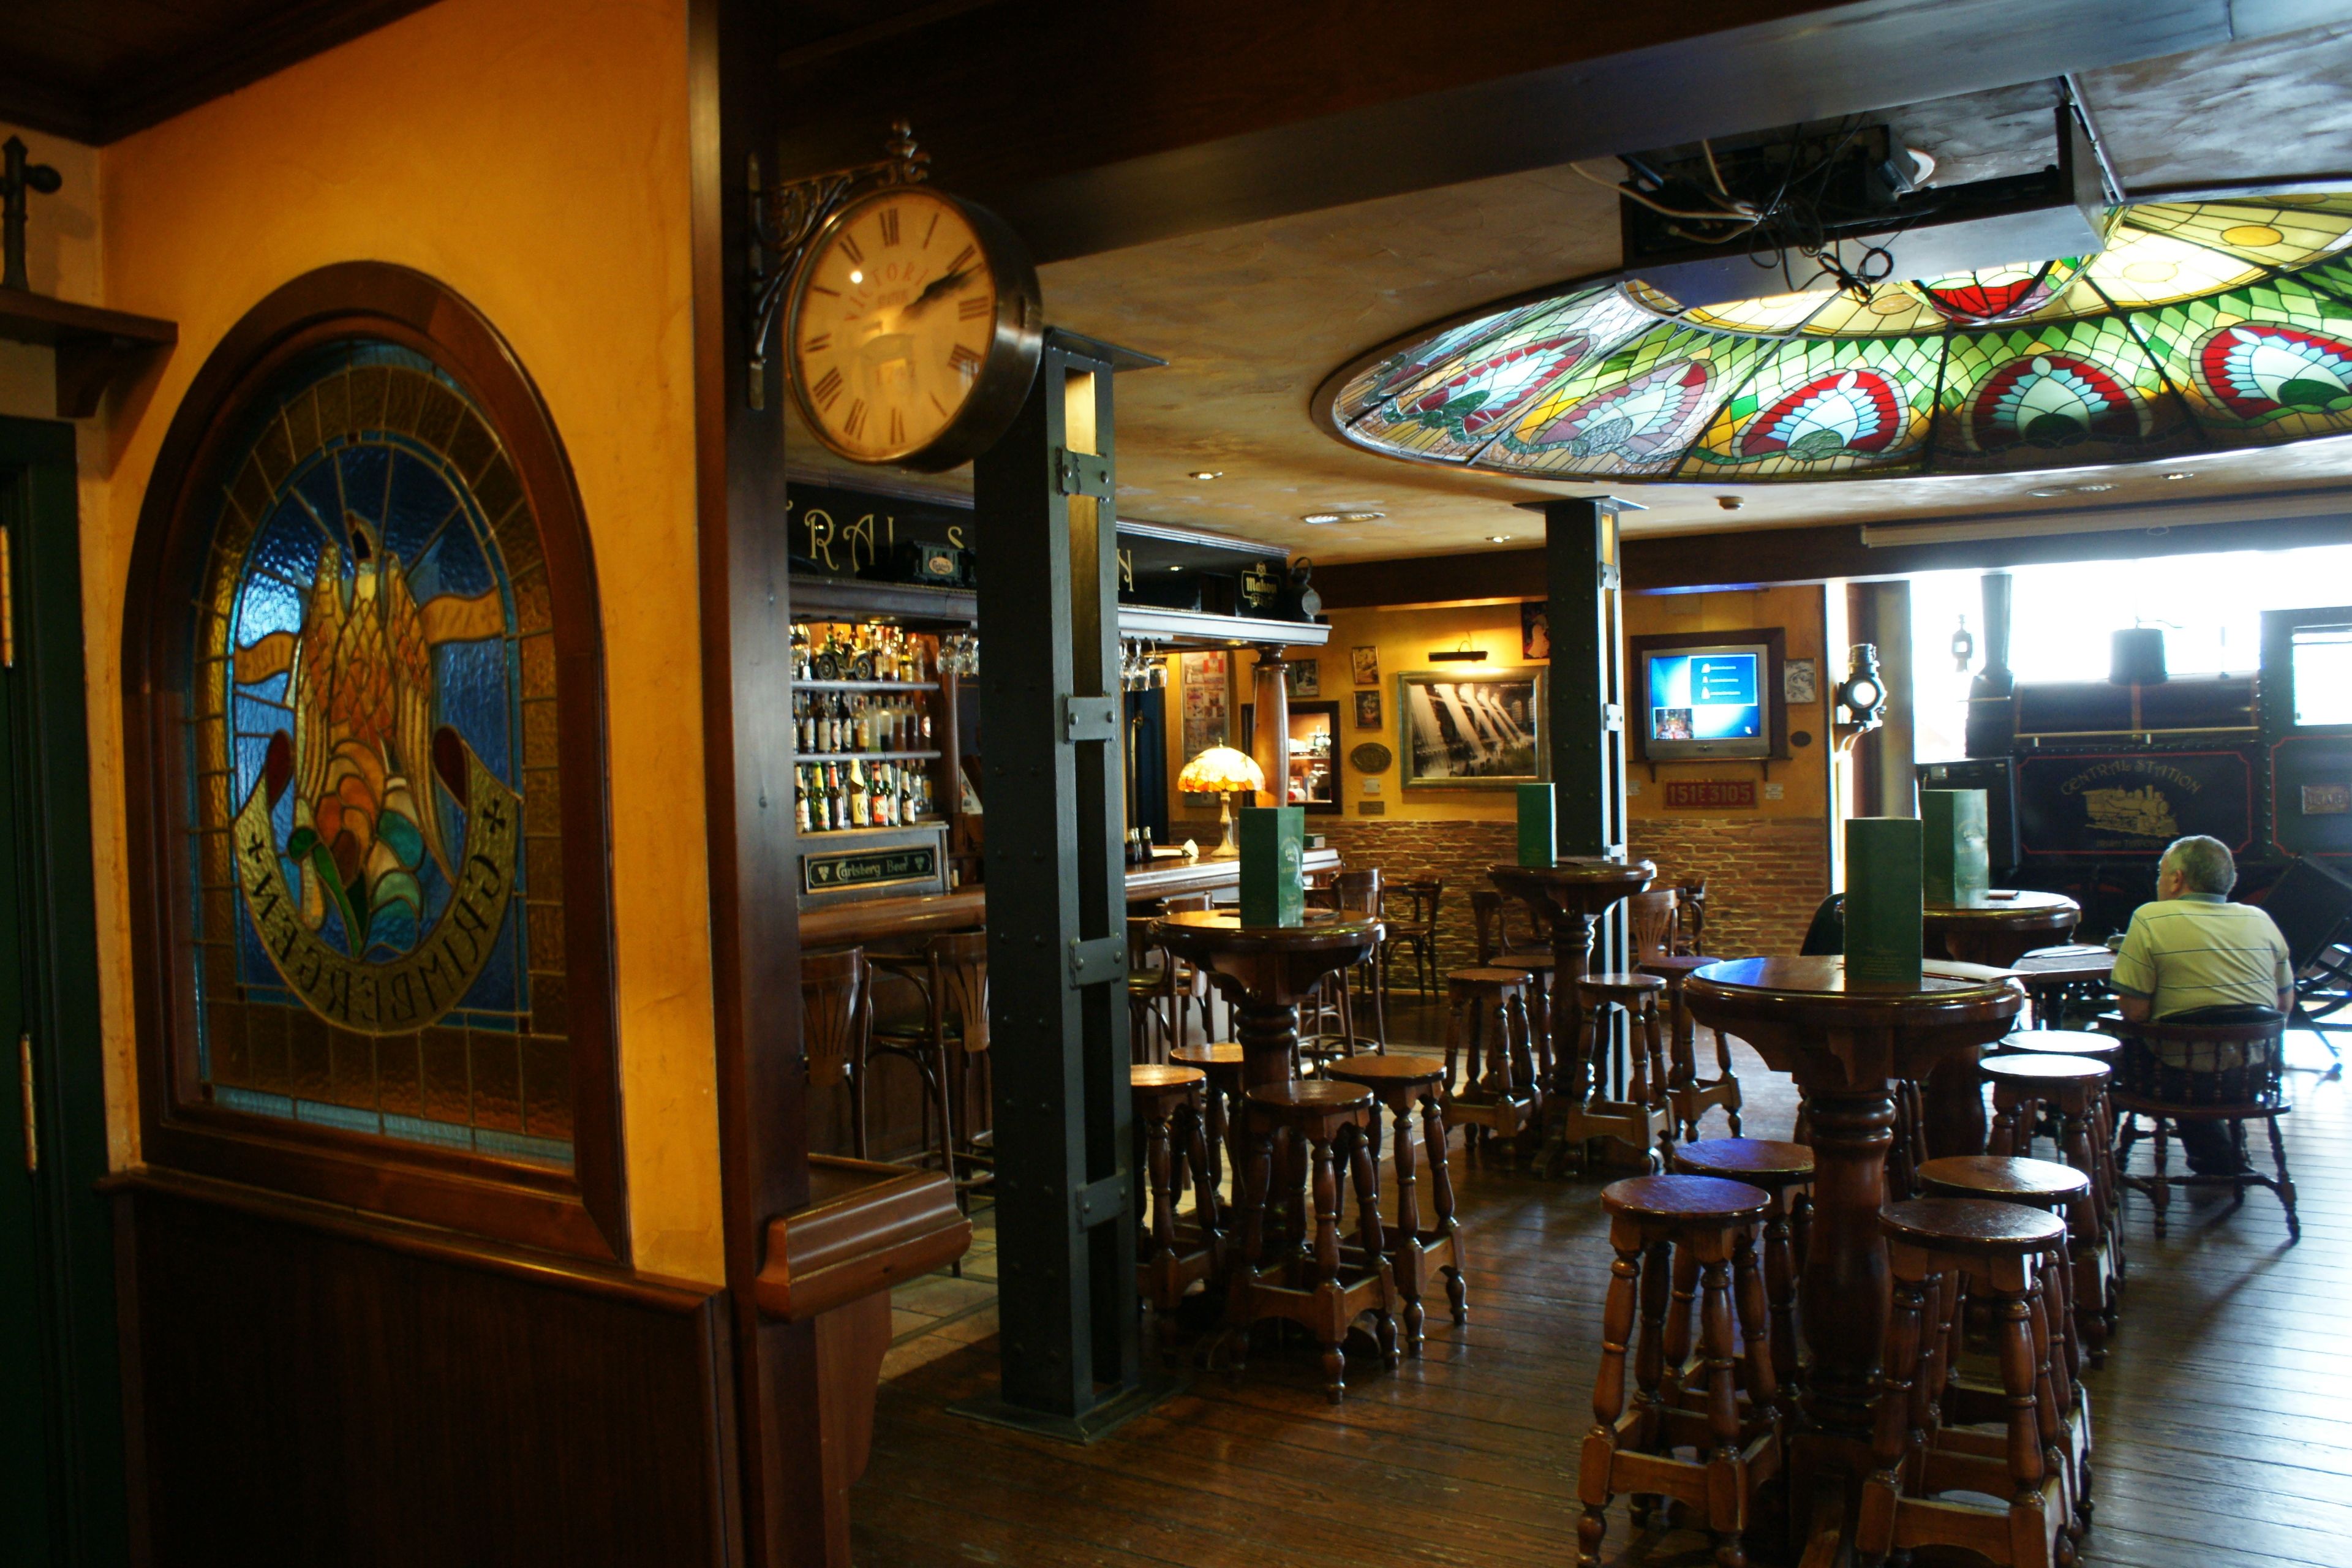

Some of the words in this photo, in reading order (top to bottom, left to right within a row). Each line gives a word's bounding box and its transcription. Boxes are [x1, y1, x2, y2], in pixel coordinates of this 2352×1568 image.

[844, 262, 930, 322] VICTORI
[2060, 760, 2132, 796] CENTRAL
[2135, 760, 2203, 794] STATION
[835, 861, 881, 881] Carlsberg
